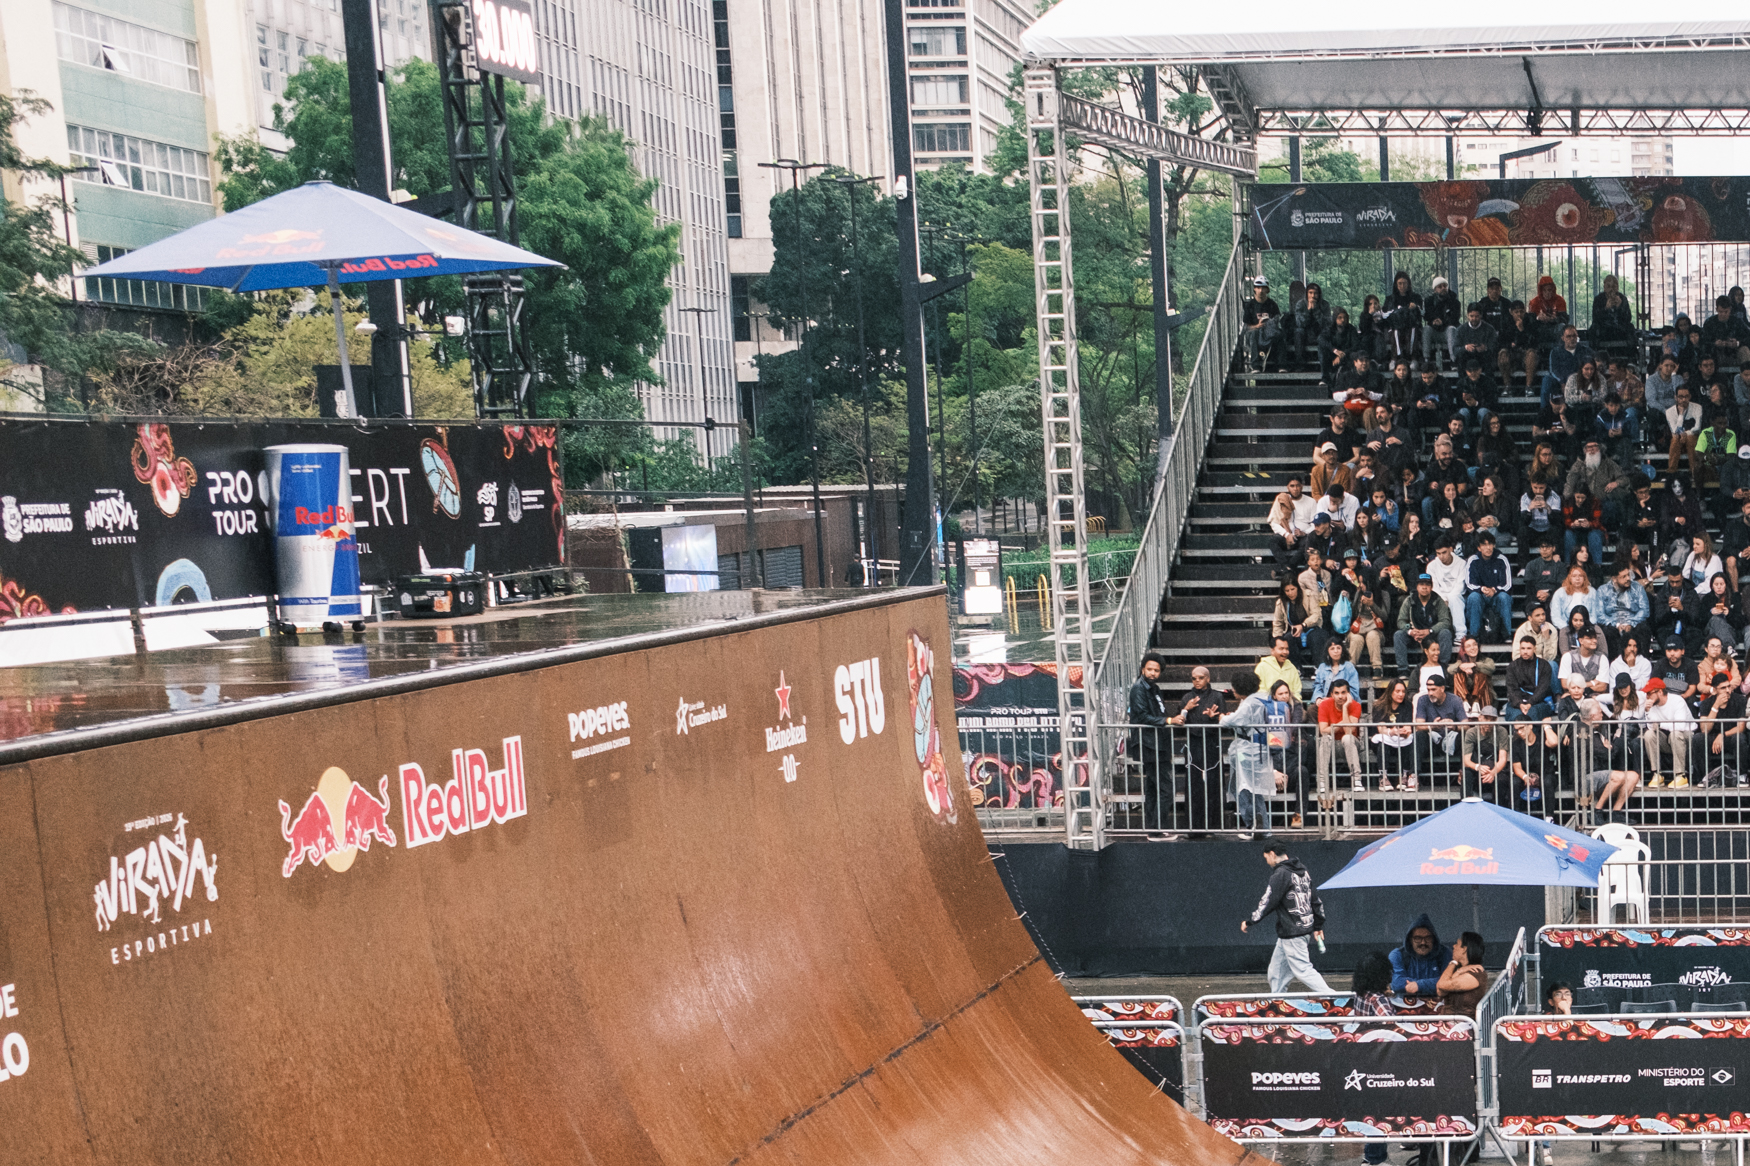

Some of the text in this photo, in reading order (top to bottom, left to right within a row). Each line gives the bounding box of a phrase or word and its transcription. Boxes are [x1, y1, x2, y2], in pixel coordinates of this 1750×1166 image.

[473, 0, 536, 73] 30.000
[1305, 216, 1343, 224] SÃO PAULO
[206, 470, 254, 505] PRO
[20, 503, 71, 516] PREFEITURA DE
[294, 505, 335, 525] Red
[484, 506, 495, 522] SP
[23, 516, 74, 533] SÃO PAULO
[212, 509, 259, 536] TOUR
[91, 535, 138, 546] ESPORTIVA
[834, 657, 886, 745] STU
[688, 703, 728, 728] Cruzeiro do Sul
[990, 707, 1009, 716] PRO
[1010, 707, 1033, 715] TOUR
[765, 721, 808, 753] Heineken
[782, 753, 797, 783] 0.0
[399, 735, 528, 849] Red Bull
[1420, 861, 1500, 876] Red Bull
[111, 918, 213, 965] ESPORTIVA
[1602, 973, 1641, 981] PREFEITURA
[1602, 977, 1652, 988] SÃO PAULO
[1556, 1074, 1631, 1084] TRANSPETRO
[1638, 1066, 1705, 1077] MINISTÉRIO DO
[1366, 1077, 1435, 1088] Cruzeiro do Sul
[1663, 1077, 1705, 1087] ESPORTE
